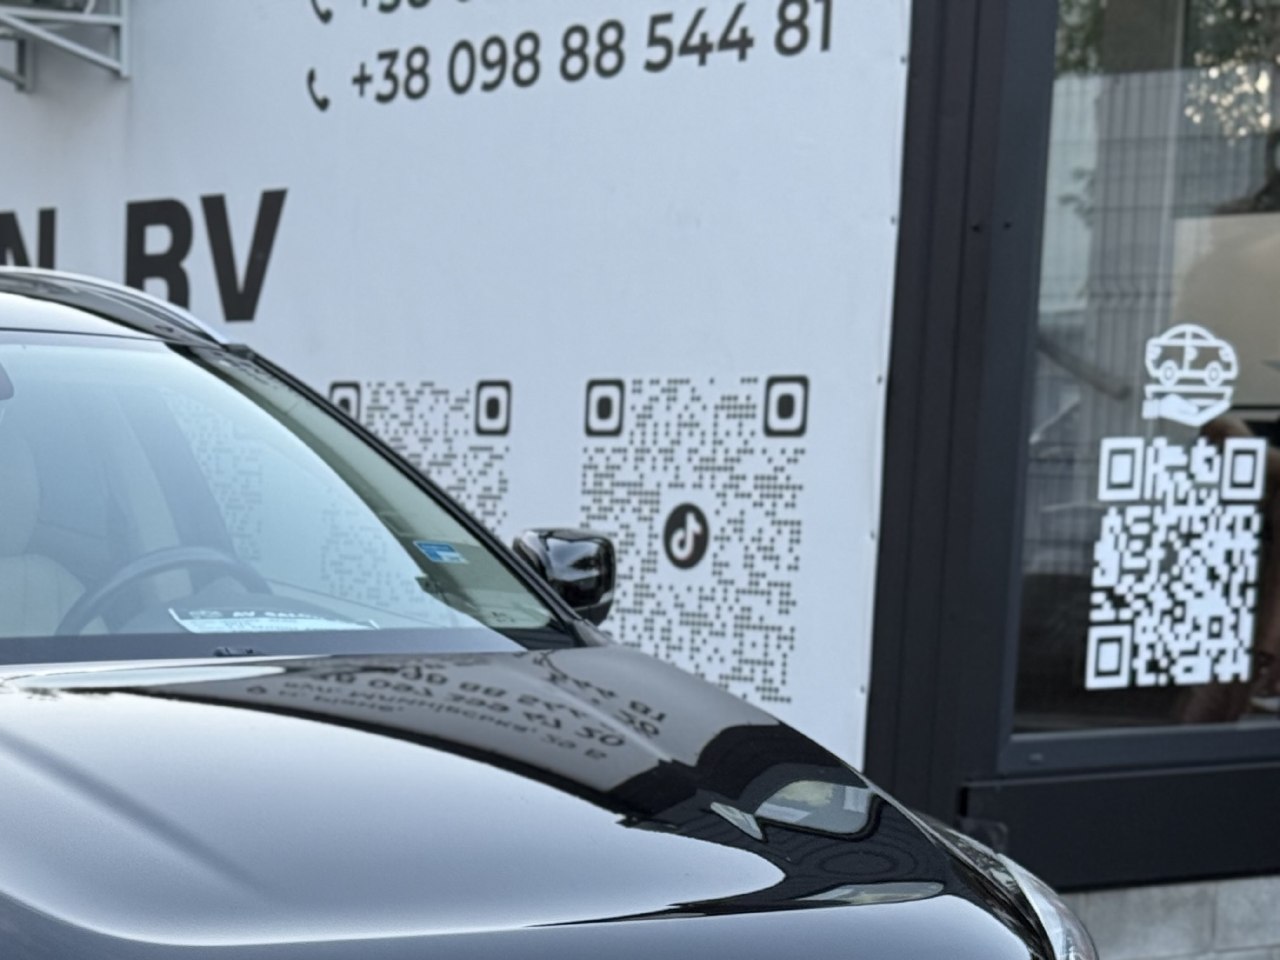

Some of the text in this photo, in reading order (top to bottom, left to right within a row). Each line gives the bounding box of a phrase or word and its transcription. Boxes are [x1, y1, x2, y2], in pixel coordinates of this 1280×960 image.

[352, 0, 832, 103] +38 098 88 544 81
[124, 188, 288, 322] RV
